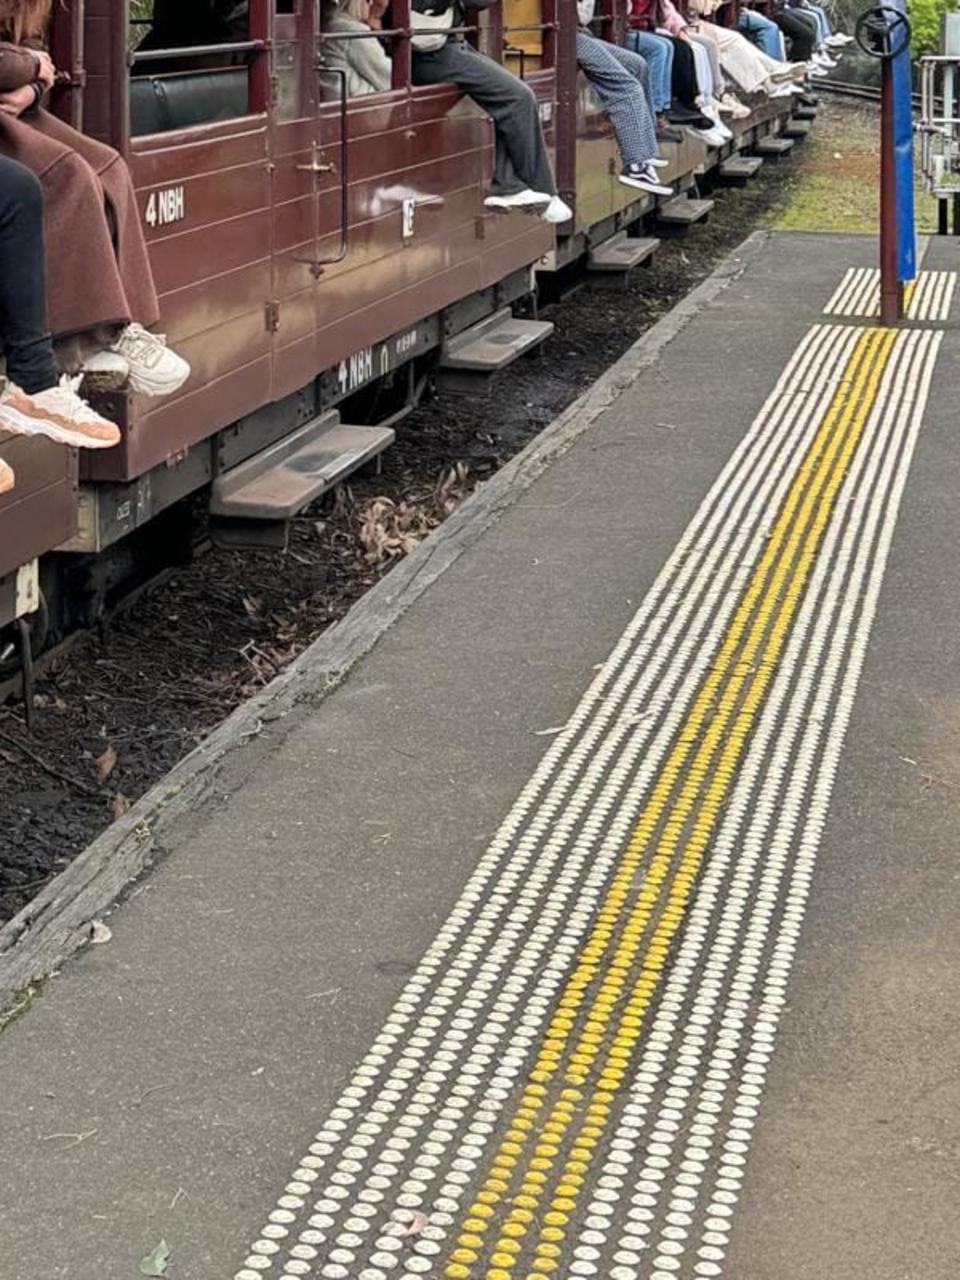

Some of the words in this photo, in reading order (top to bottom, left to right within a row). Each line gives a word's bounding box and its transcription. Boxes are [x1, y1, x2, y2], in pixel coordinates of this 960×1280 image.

[145, 192, 157, 227] 4
[159, 185, 184, 224] NBH
[338, 359, 348, 394] 4
